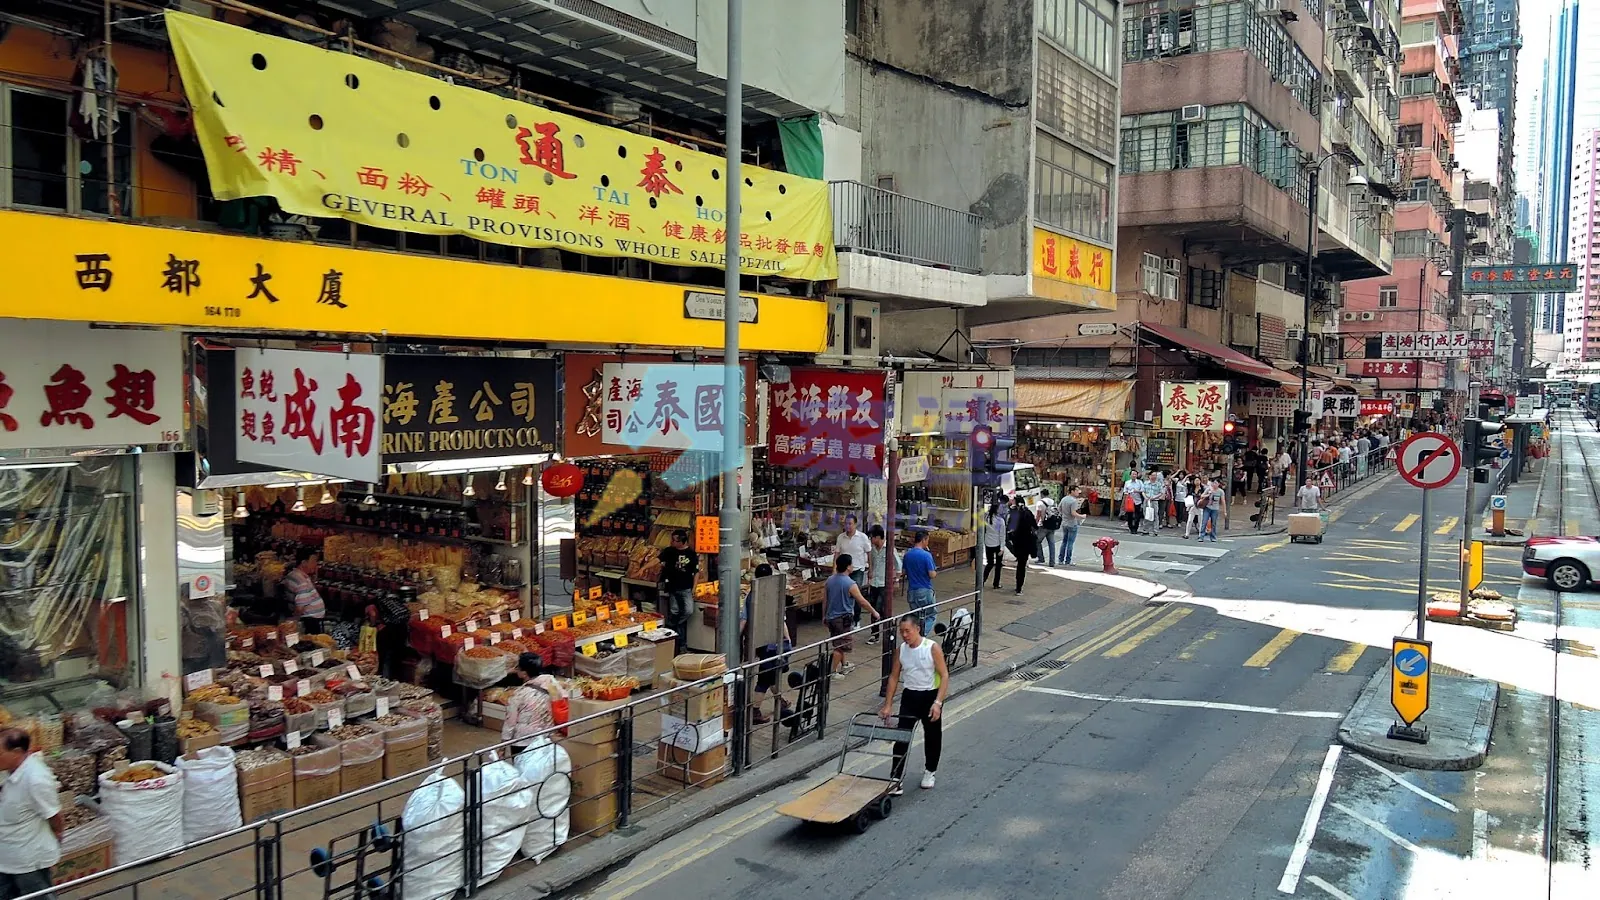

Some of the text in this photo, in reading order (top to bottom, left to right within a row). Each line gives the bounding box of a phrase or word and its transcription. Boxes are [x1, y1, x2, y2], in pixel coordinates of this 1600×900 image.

[460, 158, 727, 223] TON TAI HO
[468, 215, 604, 248] PROVISIONS
[615, 238, 681, 260] WHOLE
[75, 253, 348, 309] 西都大廈
[1041, 238, 1104, 286] 通泰行
[381, 381, 536, 426] 海產公司
[160, 430, 180, 442] 166
[428, 428, 515, 452] PRODUCTS
